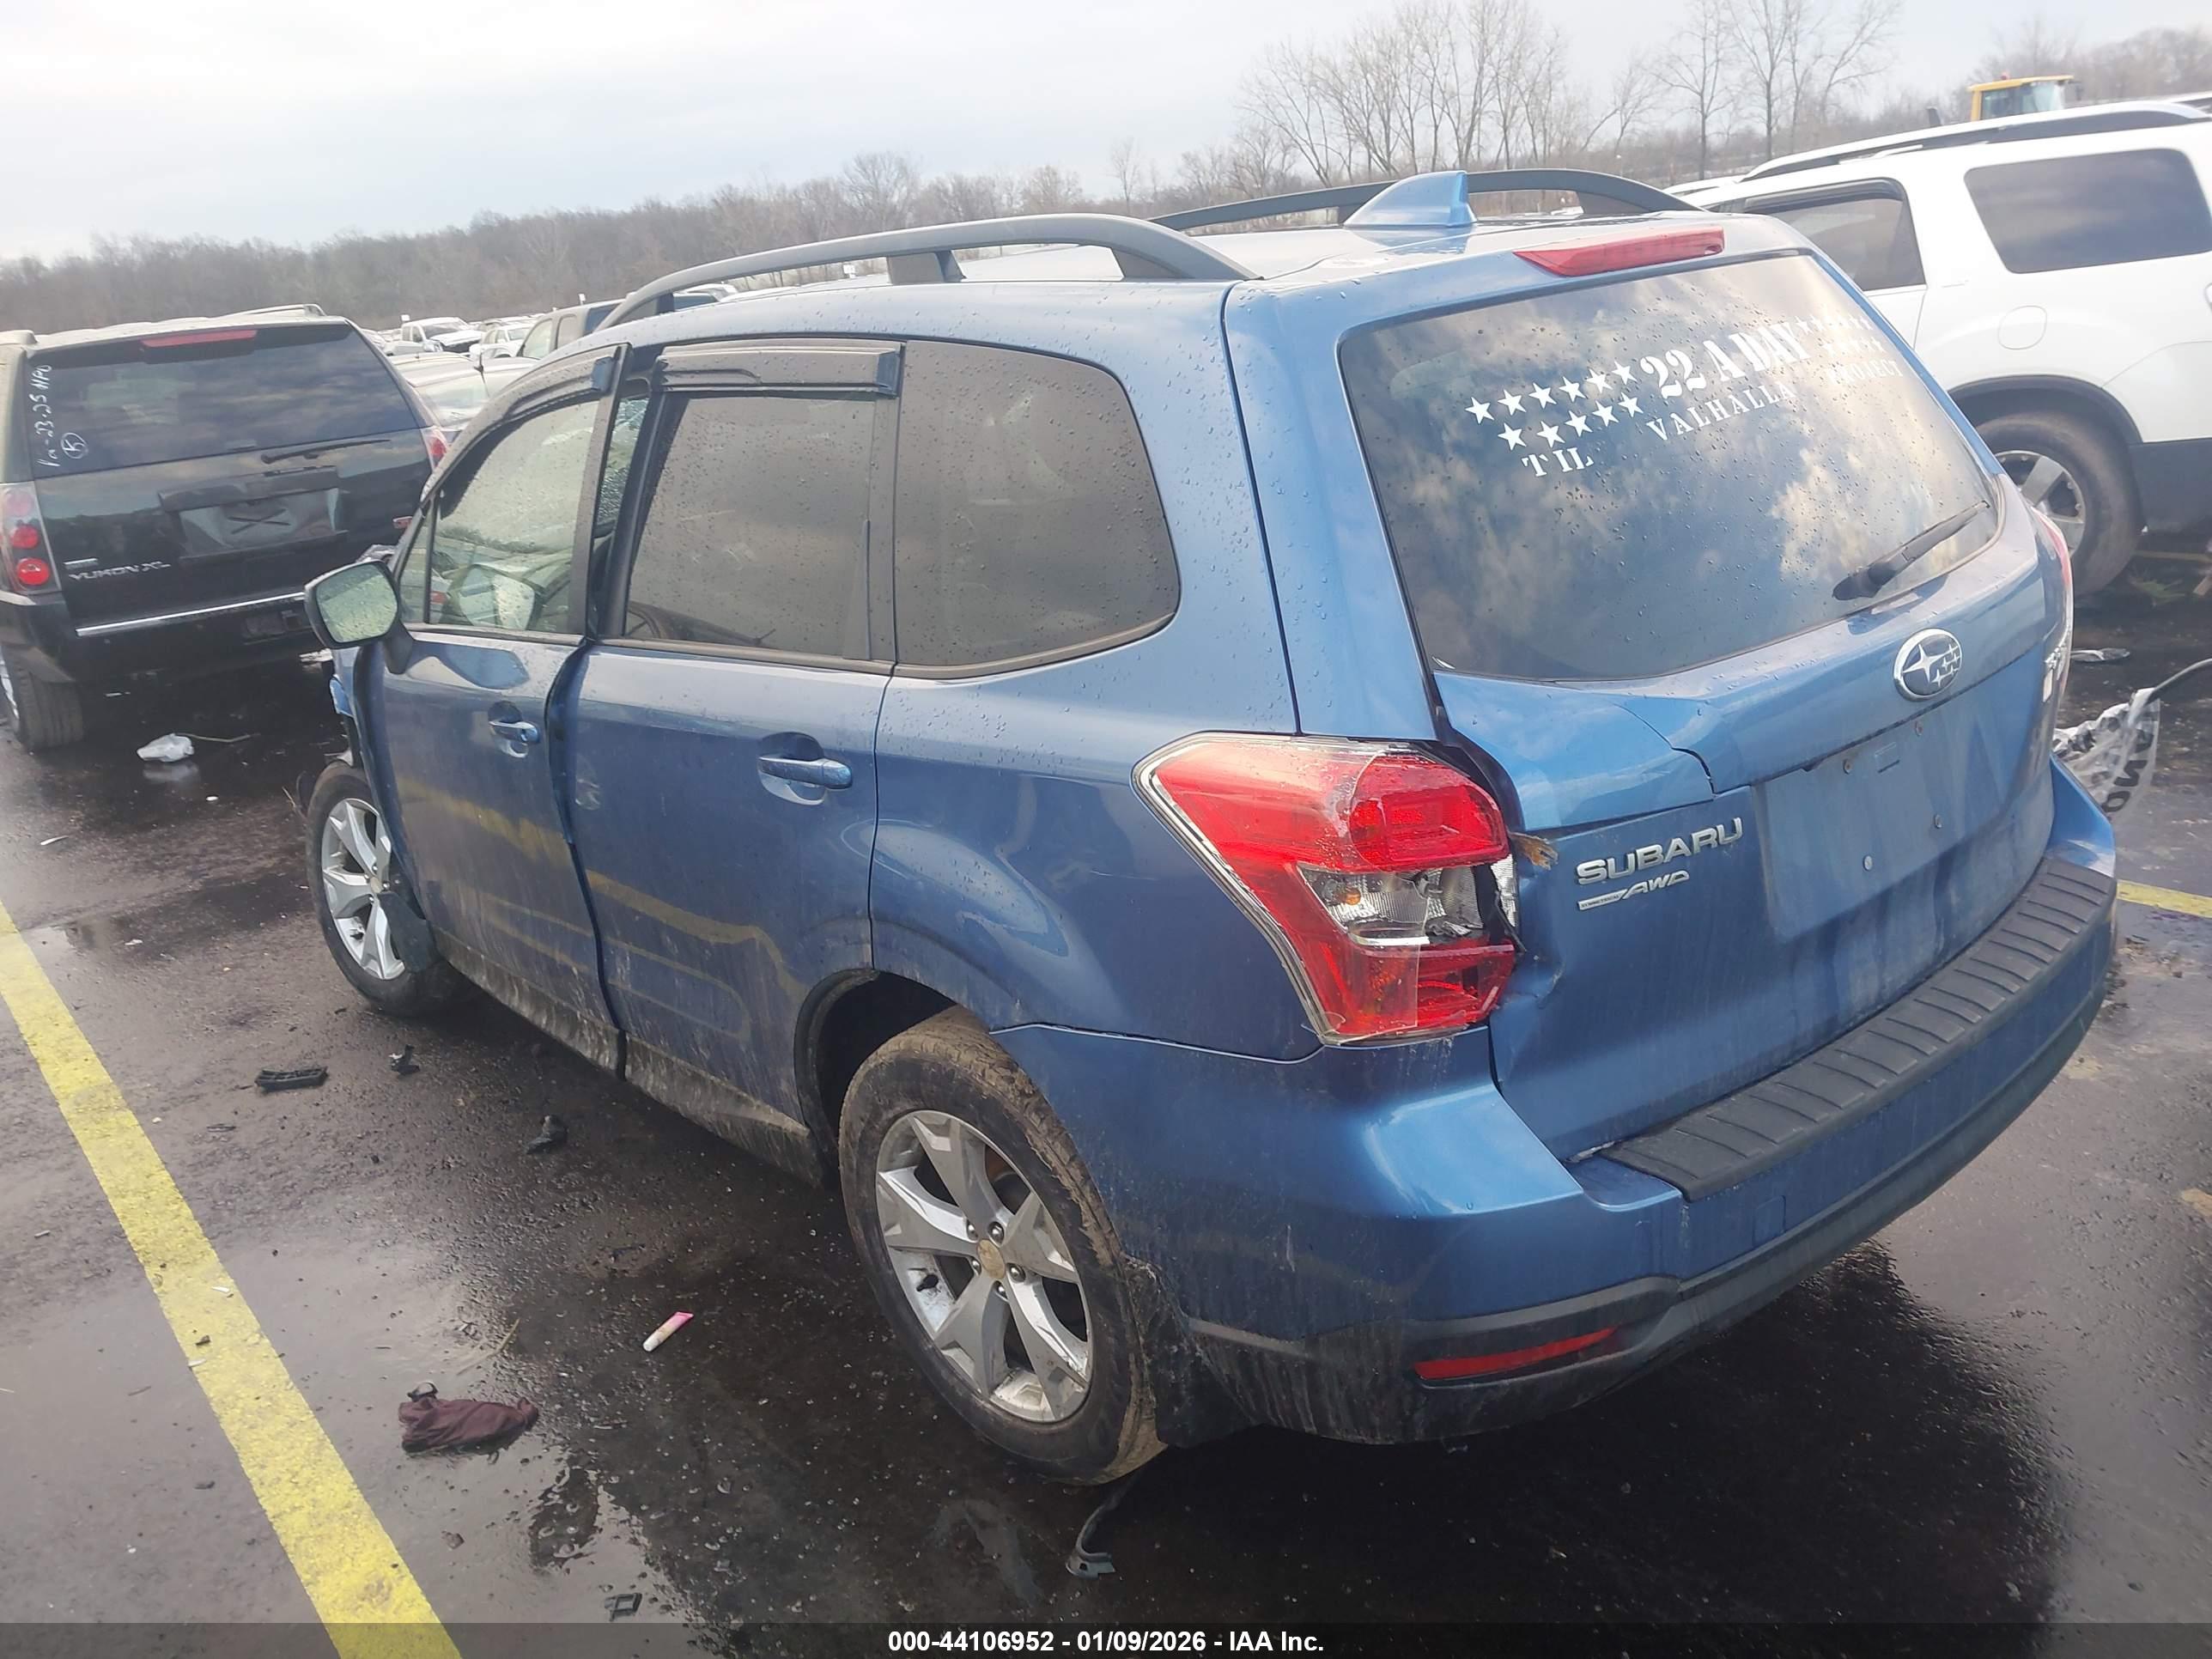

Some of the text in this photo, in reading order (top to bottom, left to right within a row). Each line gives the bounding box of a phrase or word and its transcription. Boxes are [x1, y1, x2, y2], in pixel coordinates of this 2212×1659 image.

[1639, 321, 1811, 399] 22 A DAY
[1645, 380, 1796, 441] VALHALLA
[68, 560, 172, 580] YUKON XL
[1576, 817, 1744, 885] SUBARU
[1622, 870, 1690, 900] AWD
